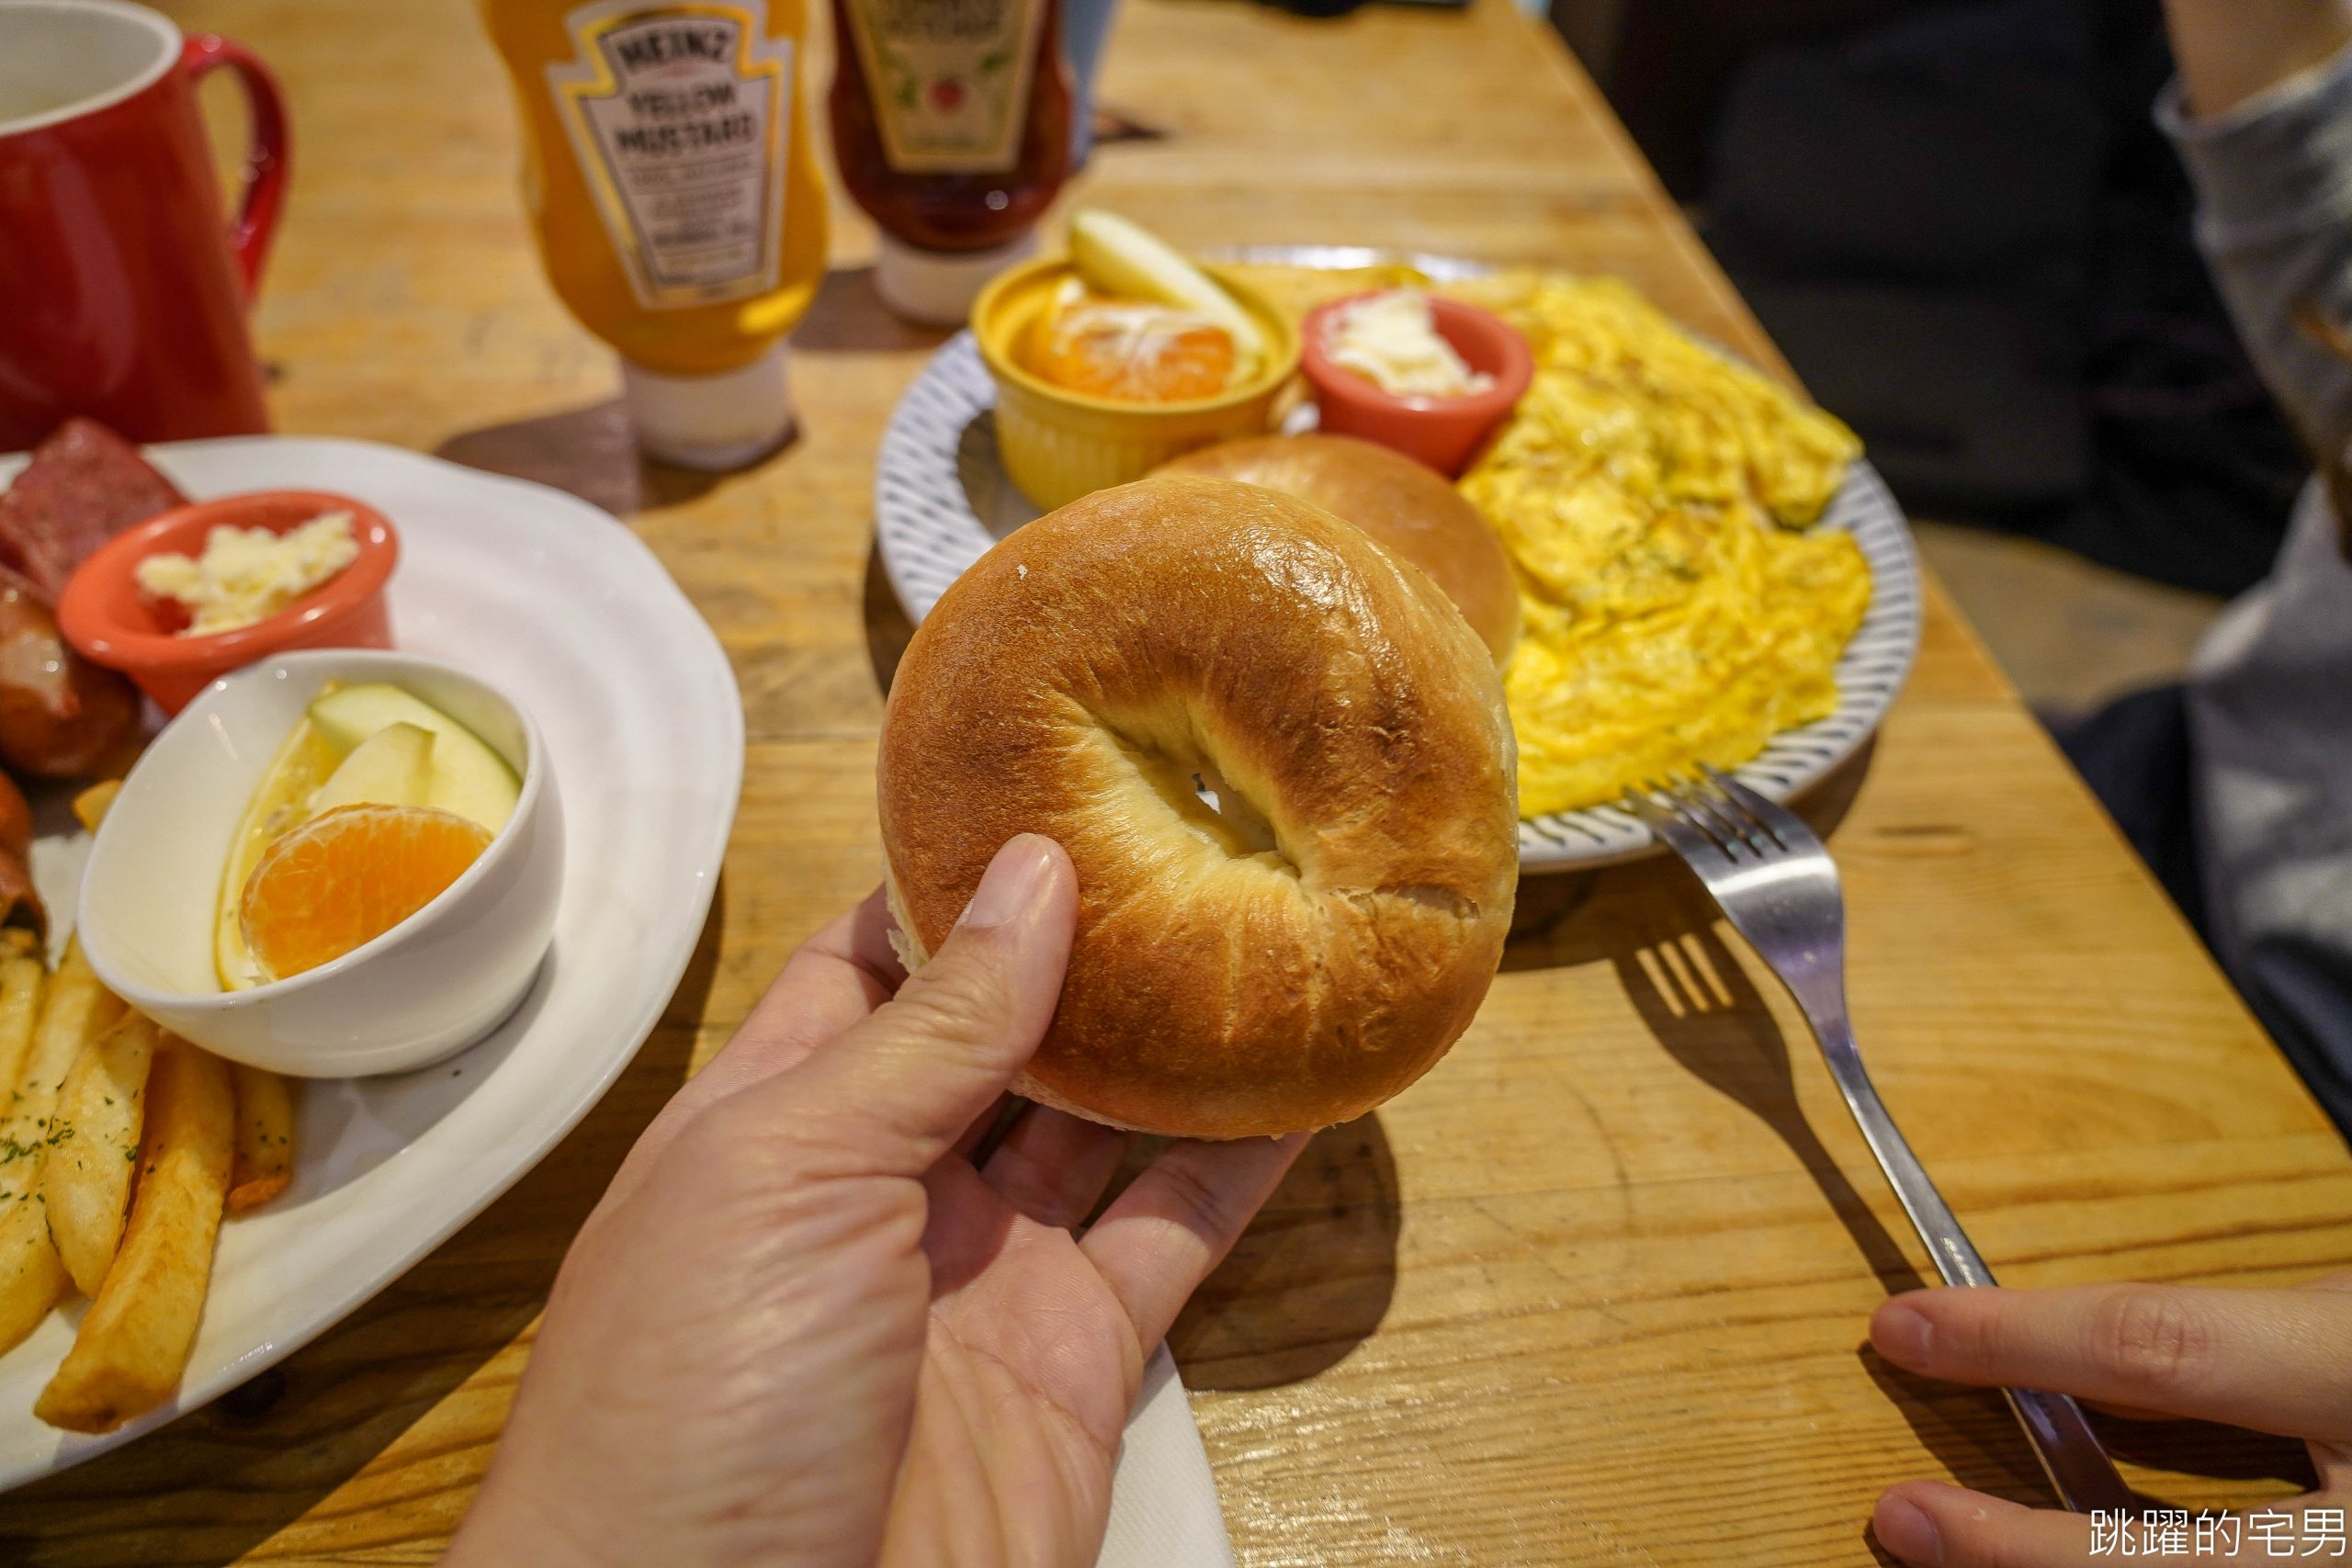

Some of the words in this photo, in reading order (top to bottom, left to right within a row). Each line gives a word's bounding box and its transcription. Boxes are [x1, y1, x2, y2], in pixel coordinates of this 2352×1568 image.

[617, 27, 731, 71] HEINZ
[628, 84, 736, 117] YELLOW
[614, 112, 757, 152] MUSTARD
